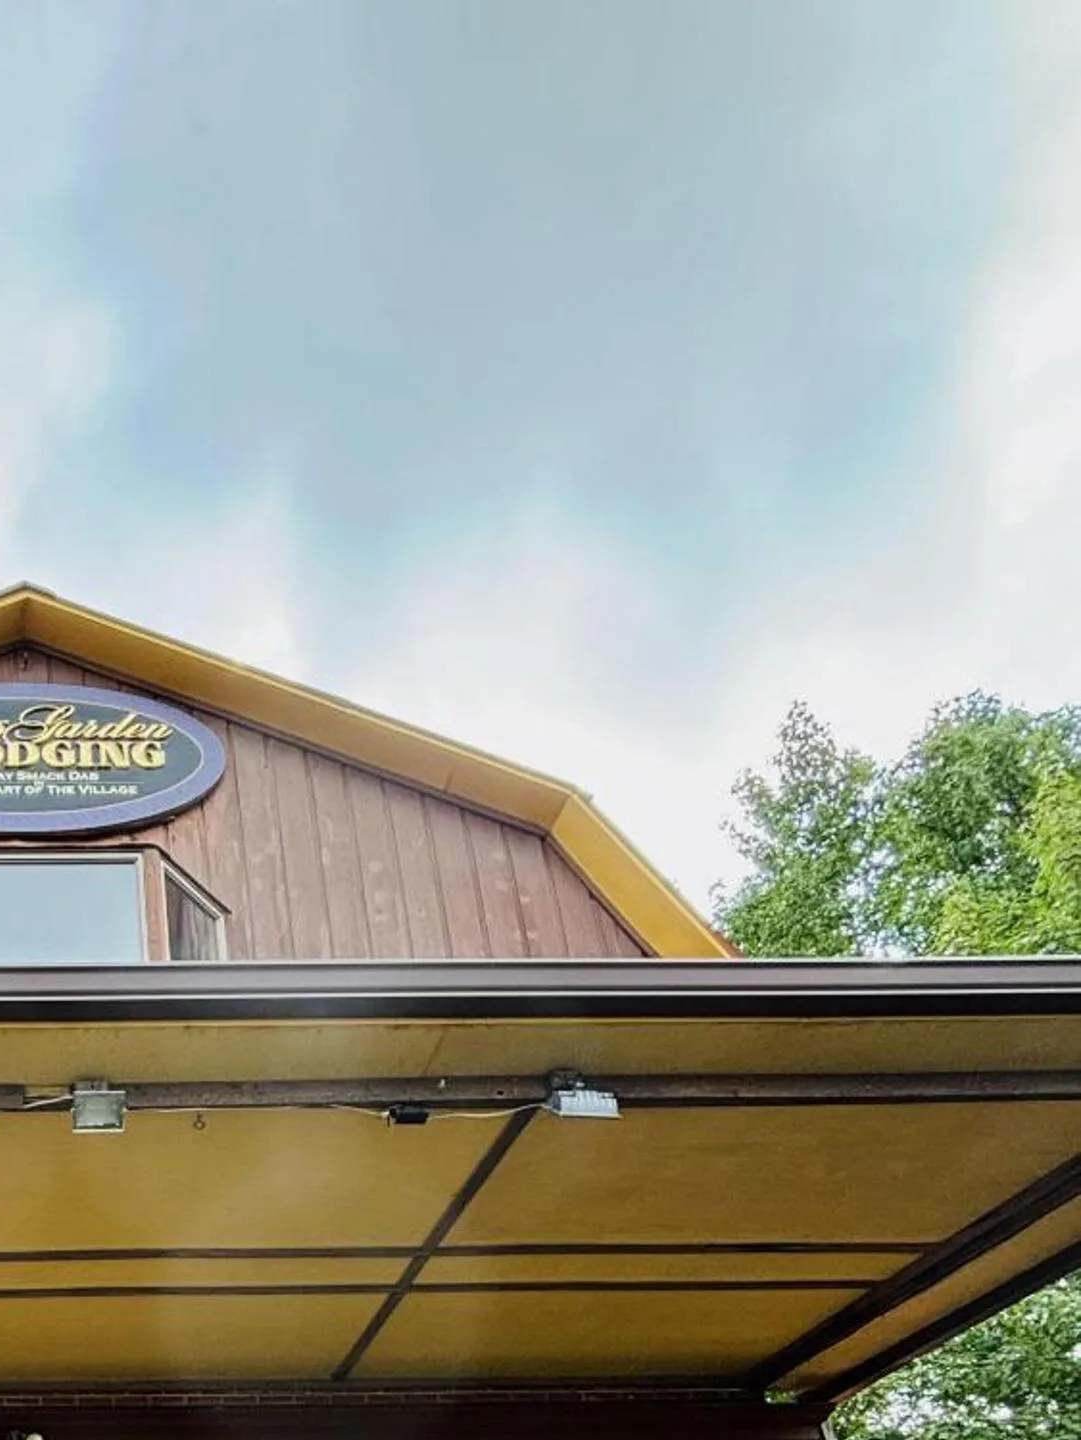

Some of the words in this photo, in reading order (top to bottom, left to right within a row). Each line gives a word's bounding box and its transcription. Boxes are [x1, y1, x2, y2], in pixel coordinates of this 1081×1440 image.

[3, 704, 173, 745] Garden
[15, 771, 66, 781] SMACK
[68, 771, 100, 781] DAB
[23, 784, 44, 795] OF
[47, 784, 77, 795] THE
[79, 784, 139, 796] VILLAGE
